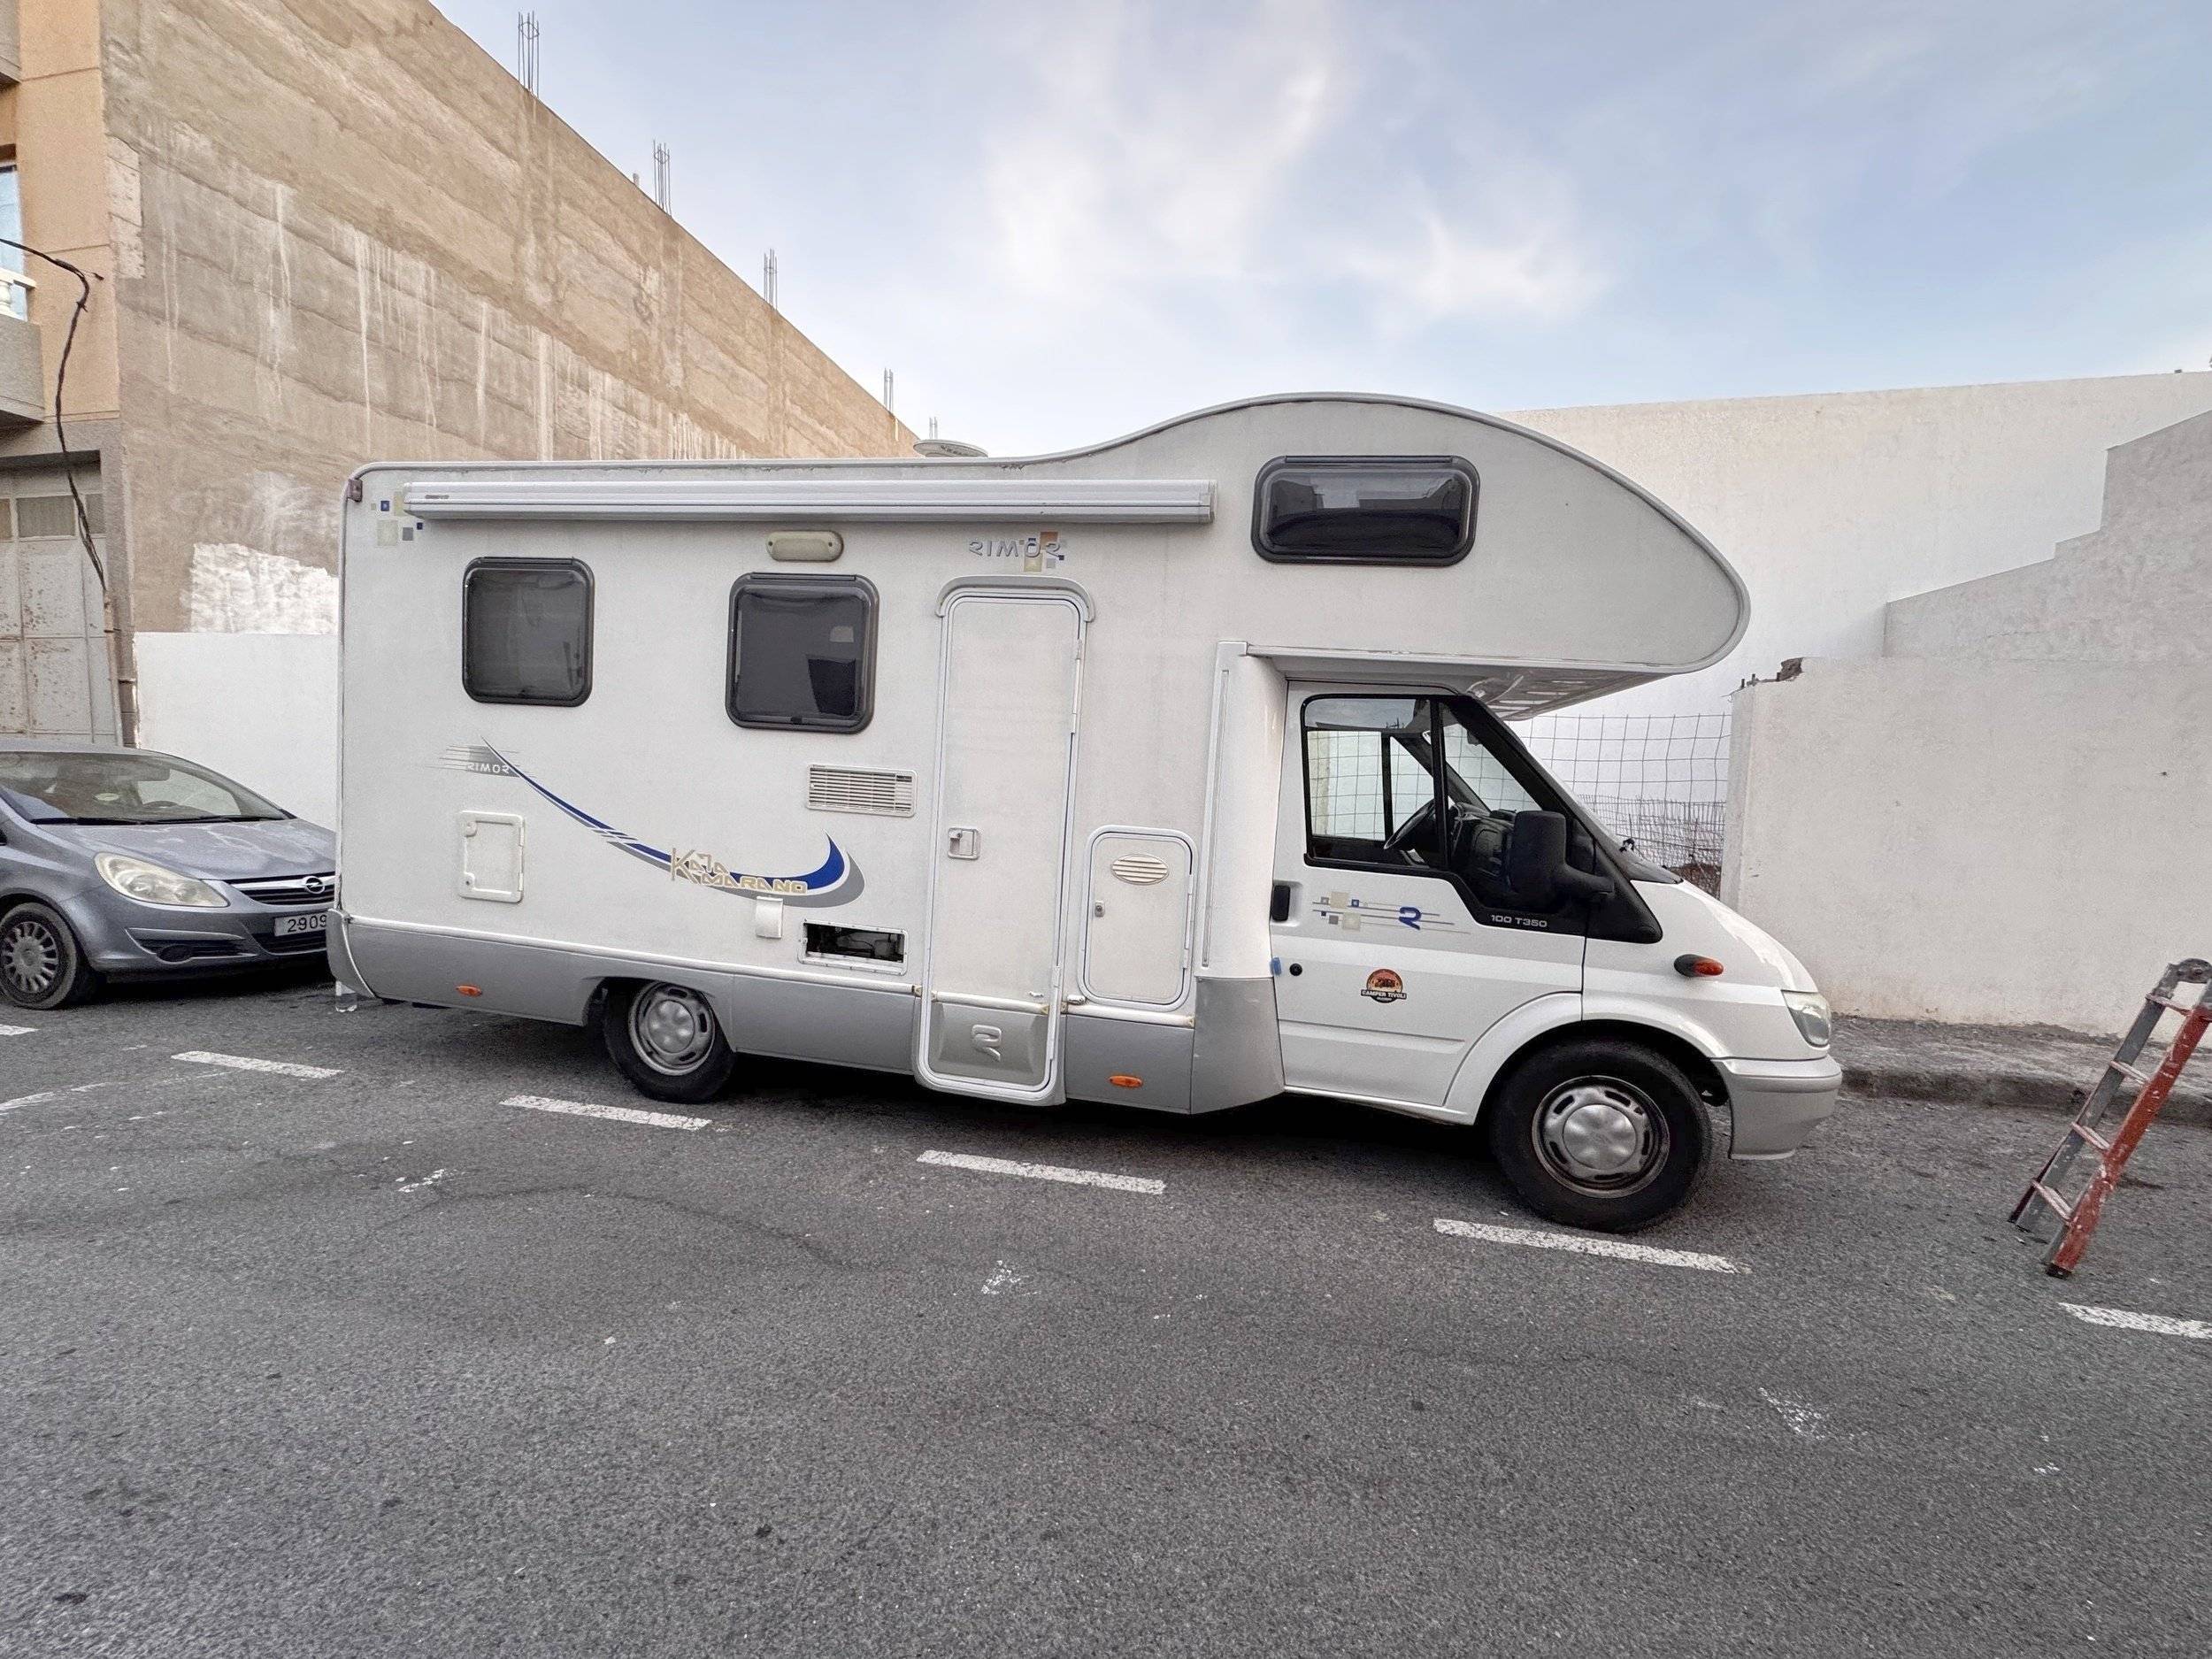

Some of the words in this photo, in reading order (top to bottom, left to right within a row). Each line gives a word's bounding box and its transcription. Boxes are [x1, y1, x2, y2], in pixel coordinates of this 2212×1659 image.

[969, 541, 1064, 559] RIMOR
[467, 764, 511, 774] RIMOR
[1491, 915, 1512, 924] 100
[1515, 918, 1548, 927] T350
